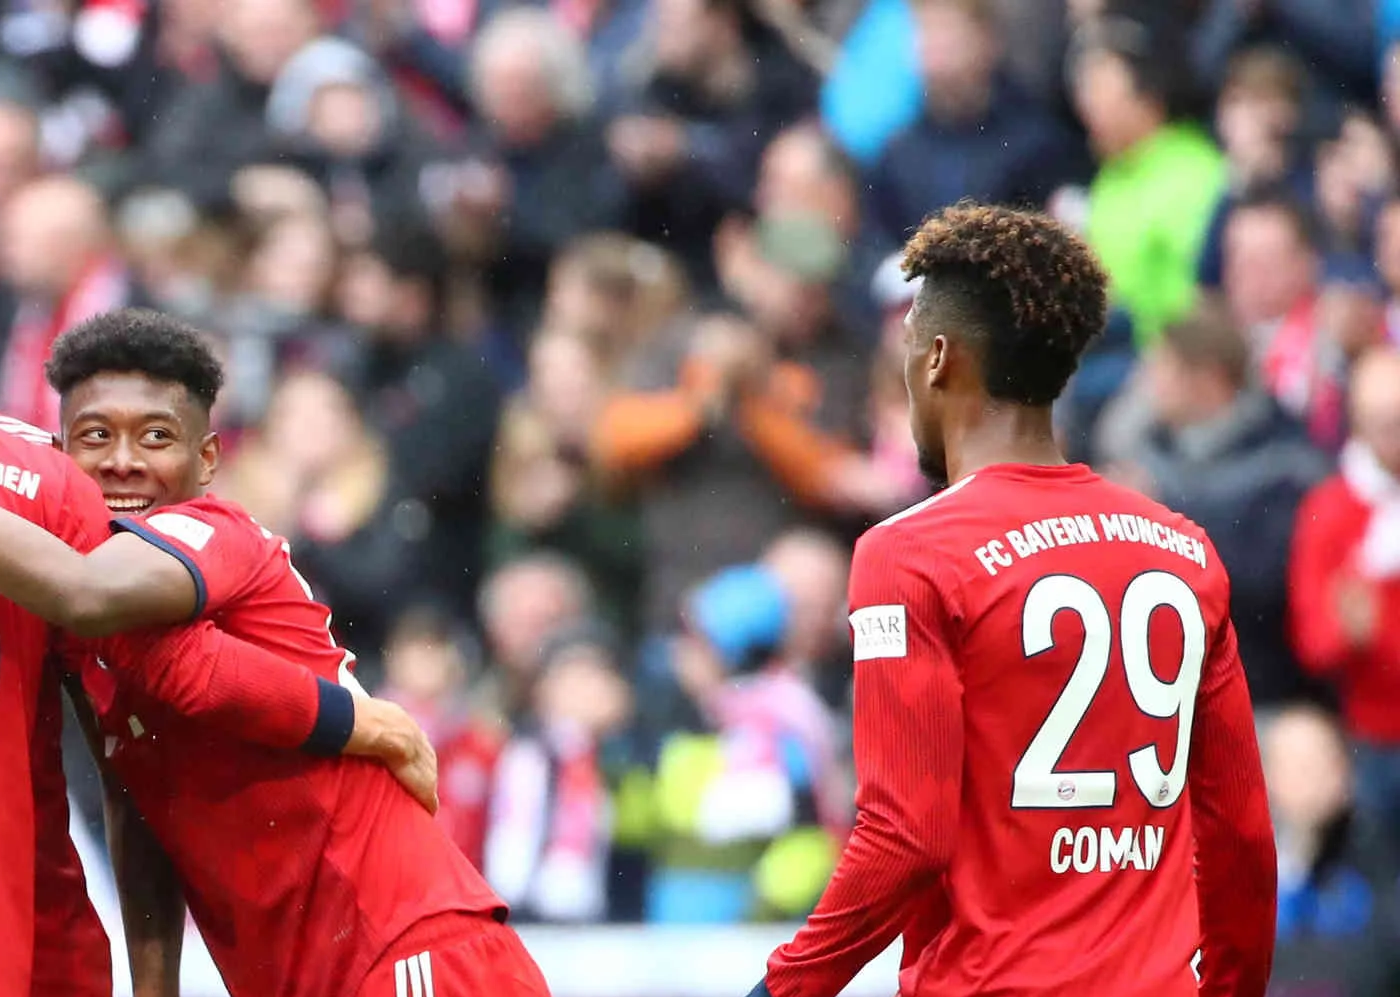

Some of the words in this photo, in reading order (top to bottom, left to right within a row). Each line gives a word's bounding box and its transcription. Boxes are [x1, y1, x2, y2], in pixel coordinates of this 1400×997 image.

[974, 539, 1013, 577] FC
[1005, 515, 1100, 559] BAYERN
[856, 614, 901, 637] ATAR
[1011, 569, 1207, 809] 29
[1050, 824, 1165, 875] COMAN
